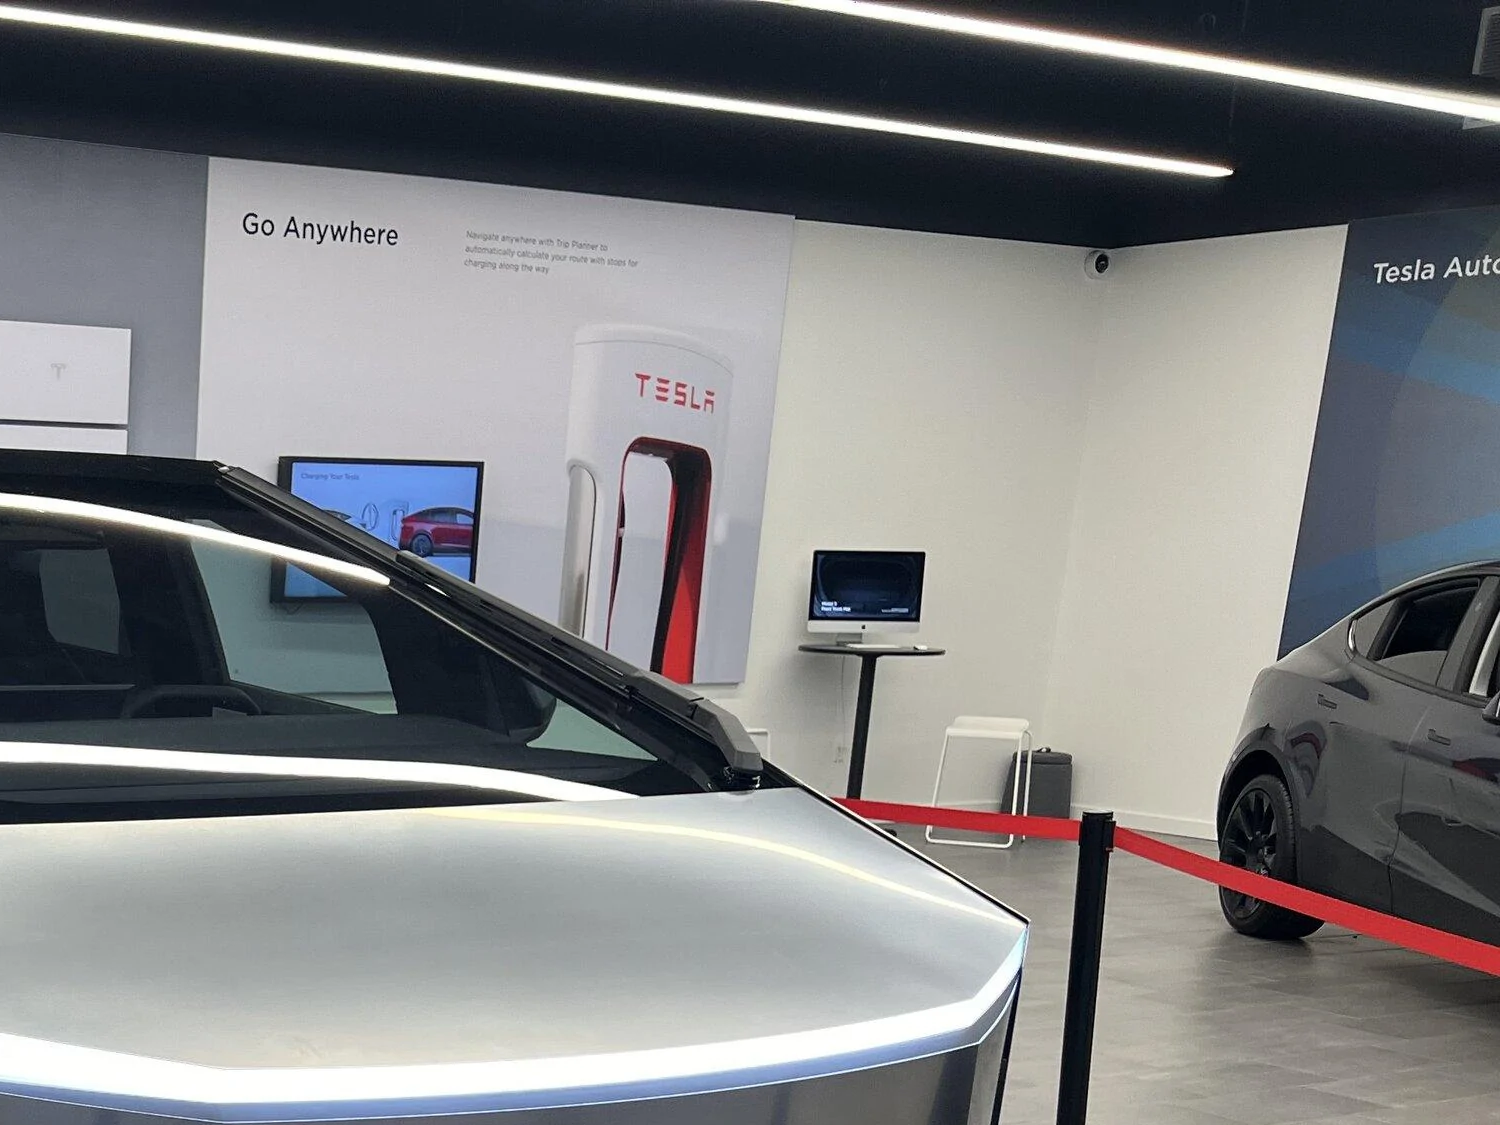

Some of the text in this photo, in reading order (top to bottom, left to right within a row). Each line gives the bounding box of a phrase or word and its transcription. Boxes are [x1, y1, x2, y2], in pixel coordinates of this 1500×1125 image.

[242, 212, 399, 245] Go Anywhere
[466, 230, 500, 242] Navigate
[501, 235, 536, 245] anywhere
[538, 238, 555, 247] with
[556, 239, 570, 249] Trip
[572, 240, 599, 250] Planner
[464, 258, 551, 275] charging along the way
[465, 245, 639, 267] automatically calculate your route with stops for
[1373, 259, 1436, 284] Tesla
[634, 372, 715, 414] TESLA
[301, 472, 328, 481] Charging
[329, 471, 344, 480] Your
